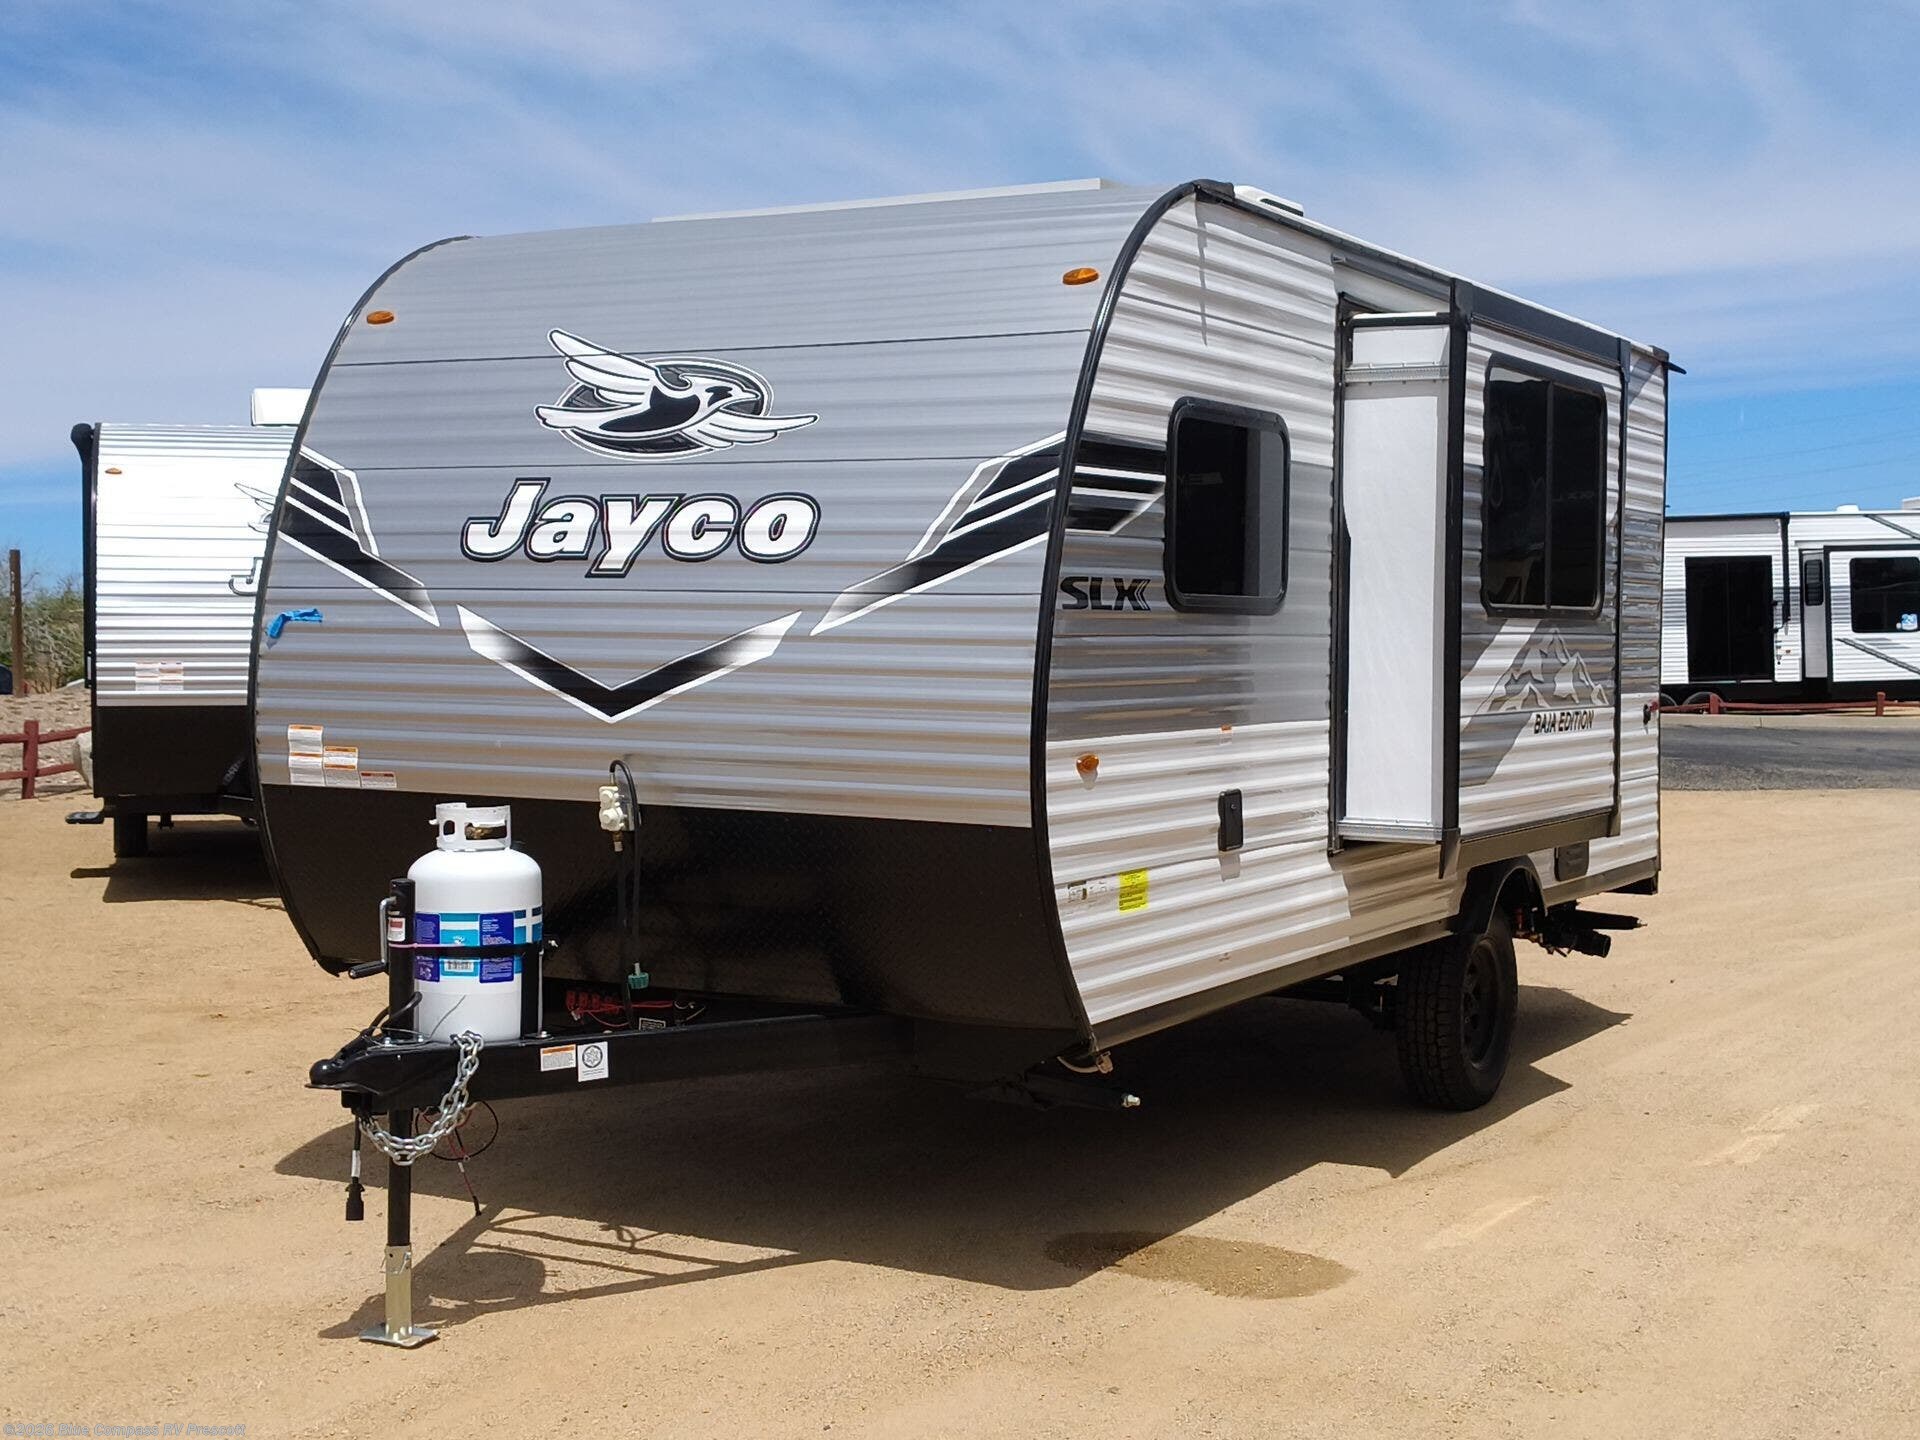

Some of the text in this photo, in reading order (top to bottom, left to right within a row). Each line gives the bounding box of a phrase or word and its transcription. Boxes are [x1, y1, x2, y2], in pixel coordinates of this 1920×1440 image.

[460, 477, 821, 579] Jayco
[1060, 576, 1151, 611] SLX
[1534, 710, 1595, 734] BAJA EDITION
